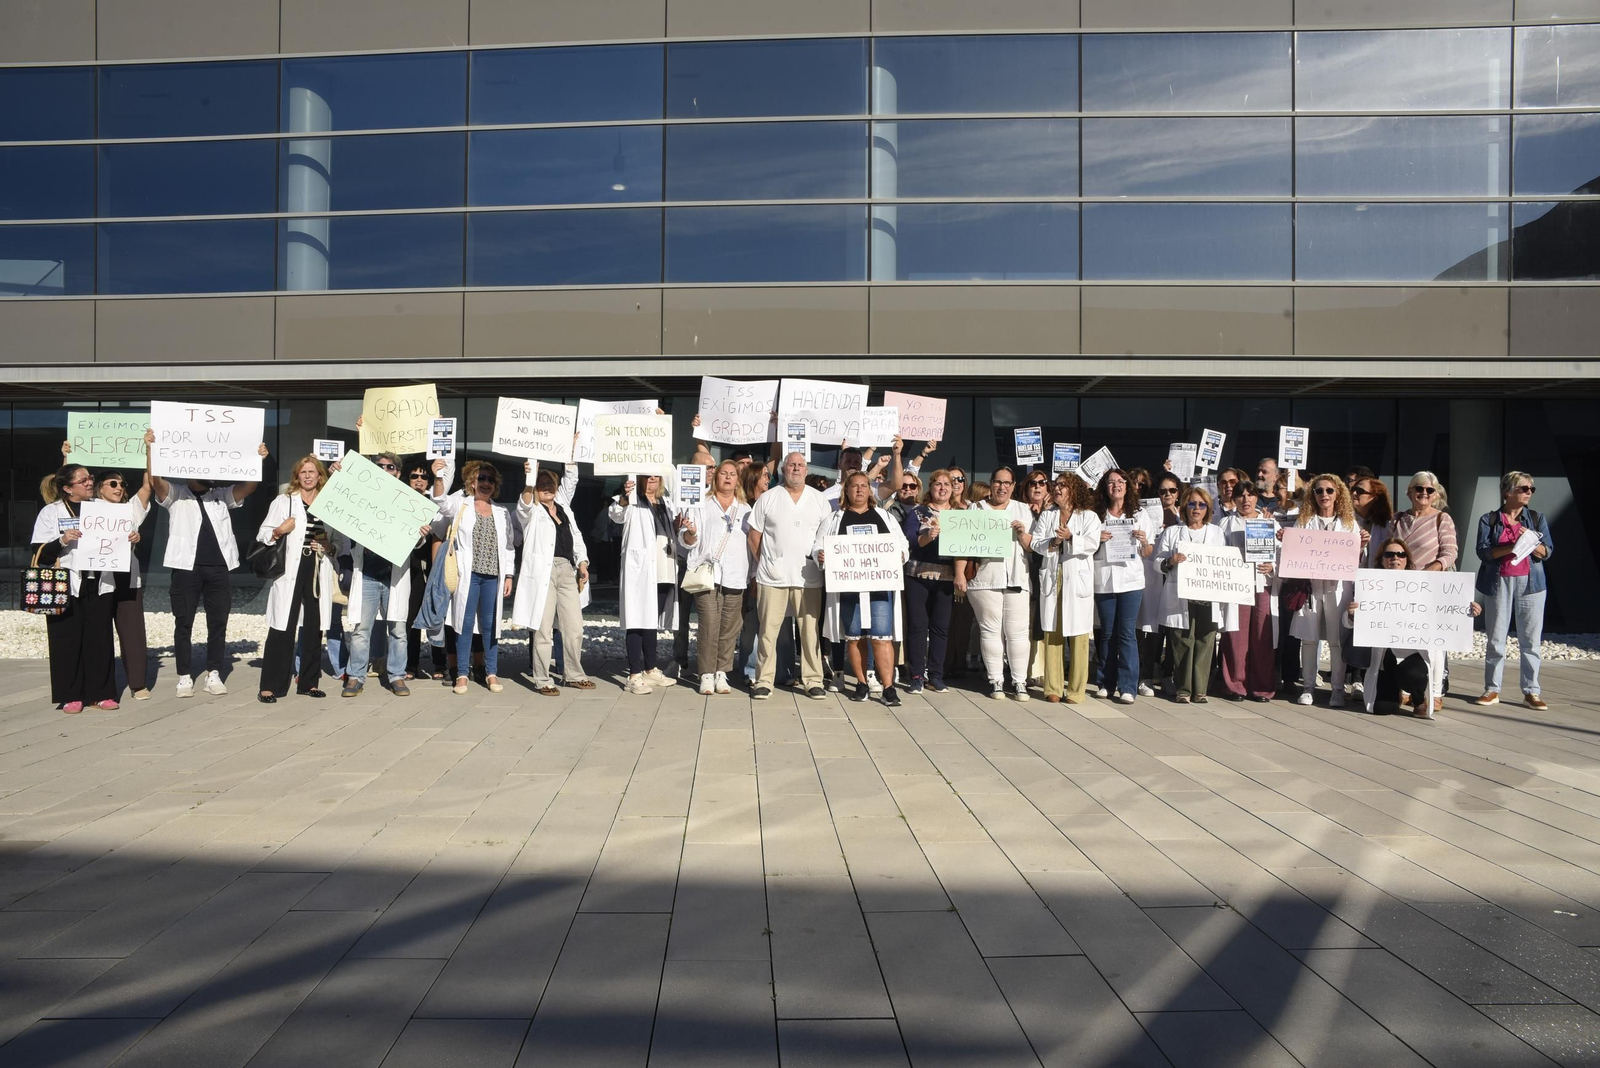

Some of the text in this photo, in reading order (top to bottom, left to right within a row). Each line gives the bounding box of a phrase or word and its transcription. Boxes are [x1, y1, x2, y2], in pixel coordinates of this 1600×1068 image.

[725, 385, 754, 397] TSS
[702, 397, 773, 414] EXIGIMOS
[793, 389, 861, 411] HACIENDA
[906, 399, 922, 410] YO
[374, 396, 438, 420] GRADO
[511, 407, 531, 420] SIN
[612, 405, 630, 414] SIN
[185, 408, 235, 424] TSS
[927, 416, 944, 424] TUS
[78, 419, 149, 432] EXIGIMOS
[604, 424, 620, 437] SIN
[711, 418, 764, 436] GRADO
[843, 420, 860, 438] YA
[862, 417, 895, 431] PAGA
[161, 430, 230, 444] POR UN
[517, 426, 549, 437] NO HAY
[875, 434, 886, 442] YA
[709, 434, 764, 443] UNIVERSITARIO
[615, 440, 653, 451] NO HAY
[160, 447, 242, 460] ESTATUTO
[101, 456, 127, 465] TSS
[168, 465, 257, 477] MARCO DIGNO
[346, 461, 386, 491] LOS
[332, 481, 396, 525] HACEMOS
[83, 515, 132, 533] GRUPO
[949, 515, 1012, 531] SANIDAD
[971, 533, 987, 541] NO
[1299, 534, 1355, 547] YO HAGO
[833, 541, 850, 554] SIN
[949, 543, 1004, 555] CUMPLE
[1310, 549, 1330, 558] TUS
[88, 557, 118, 569] TSS
[843, 557, 879, 568] NO HAY
[1187, 552, 1203, 564] SIN
[832, 569, 899, 581] TRATAMIENTOS
[1196, 568, 1231, 580] NO HAY
[1185, 577, 1251, 593] TRATAMIENTOS
[1359, 579, 1464, 595] TSS POR UN
[1359, 600, 1428, 613] ESTATUTO
[1370, 620, 1459, 632] DEL SIGLO XXI
[1389, 634, 1446, 646] DIGNO
